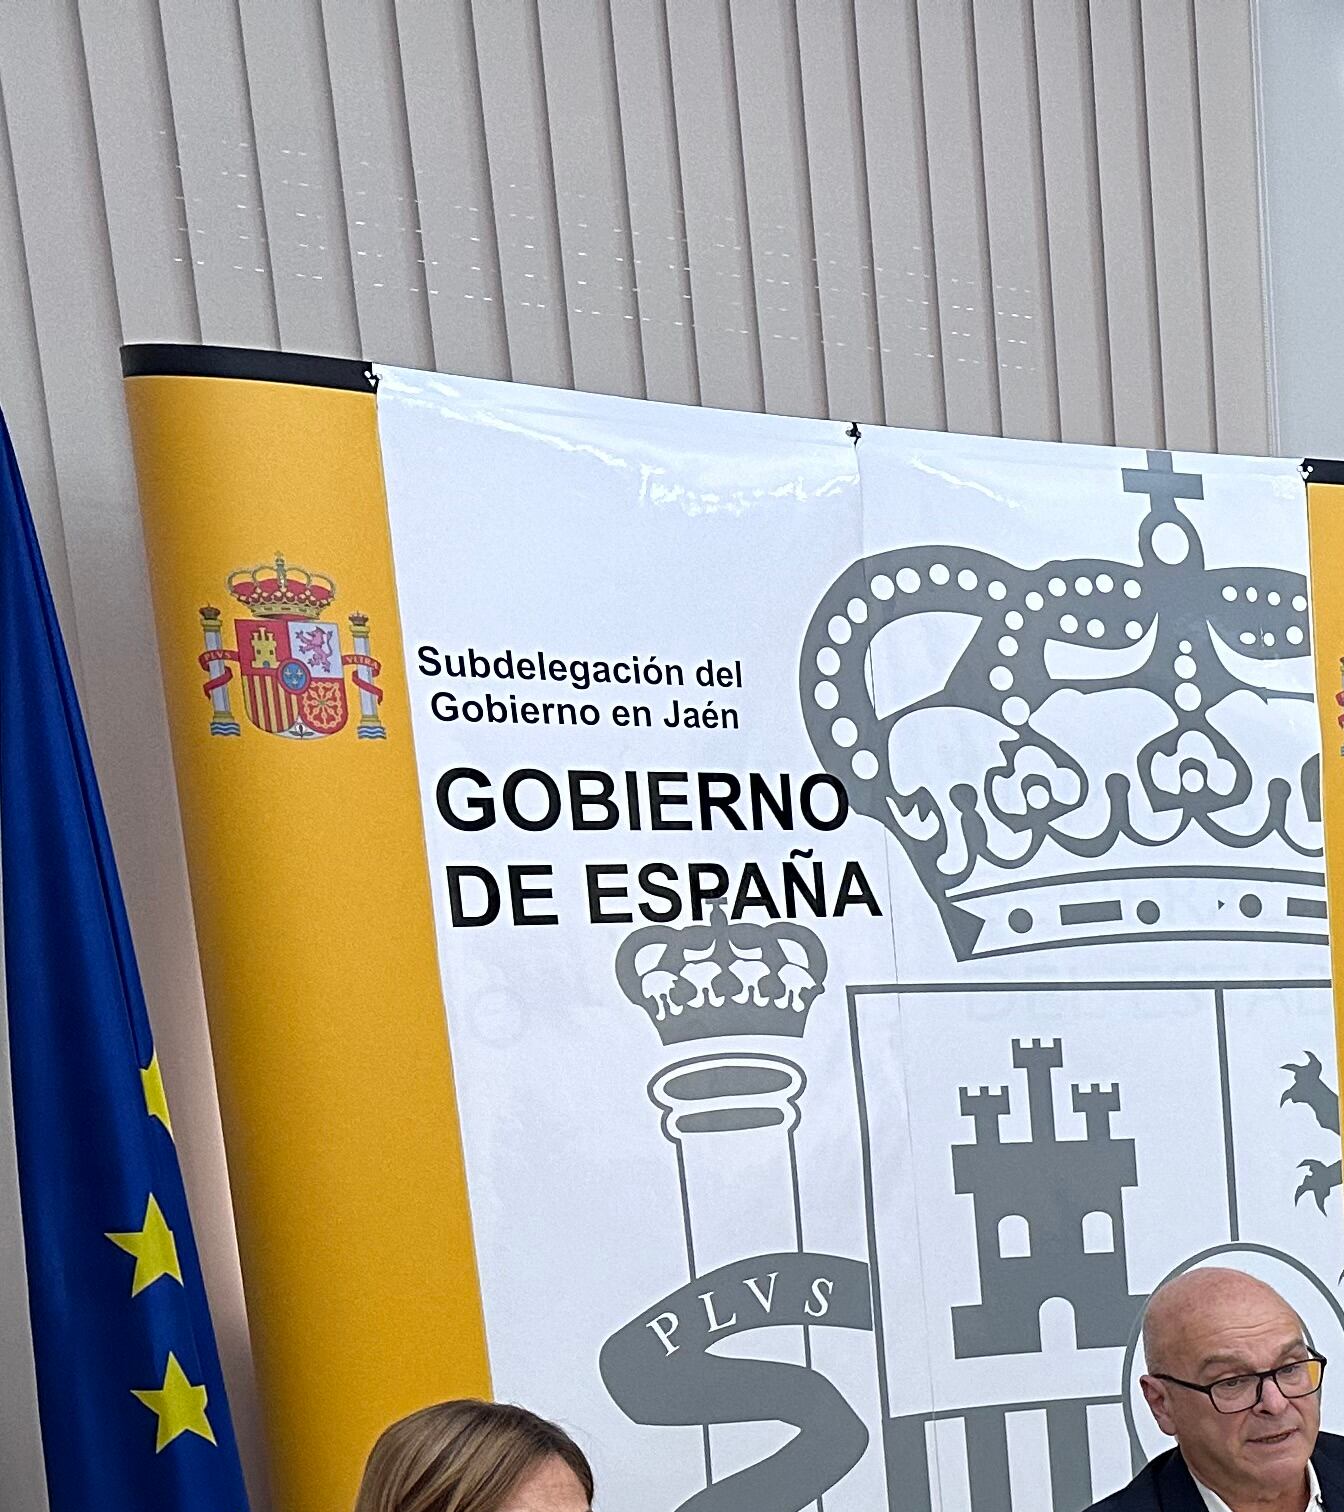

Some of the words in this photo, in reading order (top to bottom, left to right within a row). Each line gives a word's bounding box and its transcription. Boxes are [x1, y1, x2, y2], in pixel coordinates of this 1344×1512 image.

[418, 646, 684, 689] Subdelegación
[696, 660, 743, 688] del
[431, 692, 600, 726] Gobierno
[612, 704, 651, 727] en
[663, 700, 740, 729] Jaén
[435, 767, 849, 832] GOBIERNO
[445, 864, 559, 928] DE
[585, 848, 883, 925] ESPAÑA
[646, 1272, 834, 1357] PLVS
